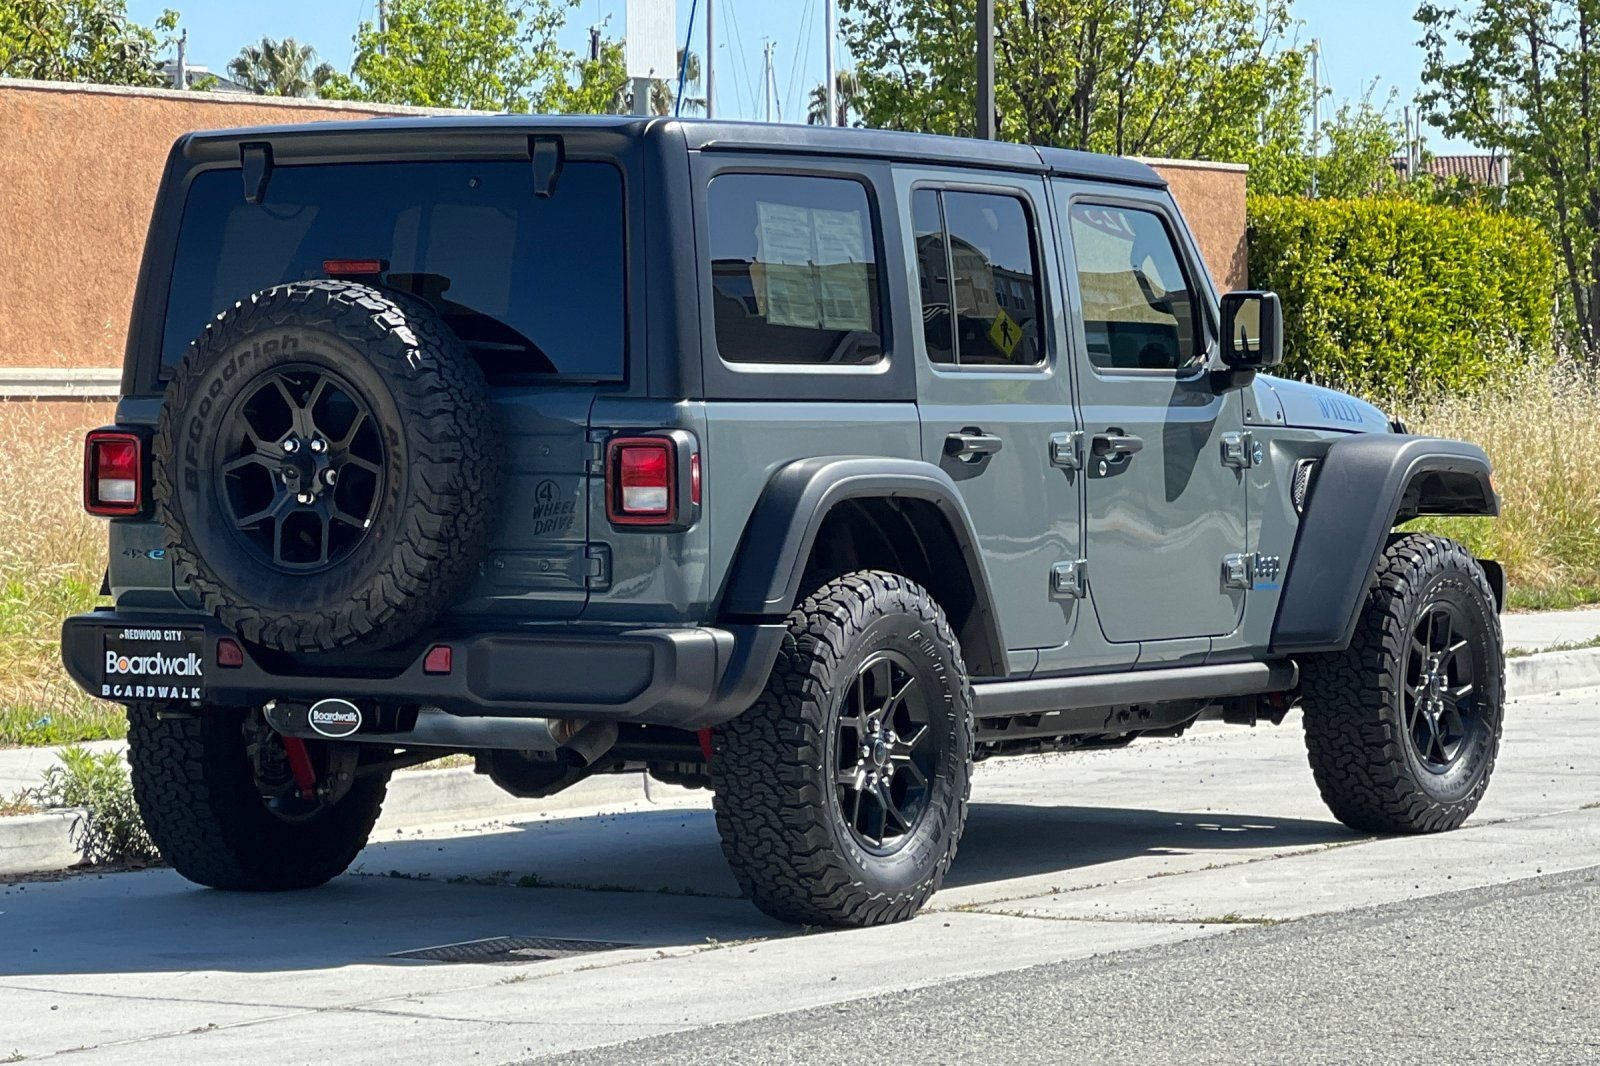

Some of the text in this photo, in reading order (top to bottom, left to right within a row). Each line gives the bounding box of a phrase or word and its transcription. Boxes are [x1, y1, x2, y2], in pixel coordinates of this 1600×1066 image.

[539, 484, 553, 499] 4
[533, 501, 577, 519] WHEEL
[533, 516, 575, 536] DRIVE
[124, 628, 183, 642] REDWOOD CITY
[105, 650, 203, 677] Boardwalk
[101, 683, 201, 700] BOARDWALK
[313, 709, 357, 722] Boardwalk
